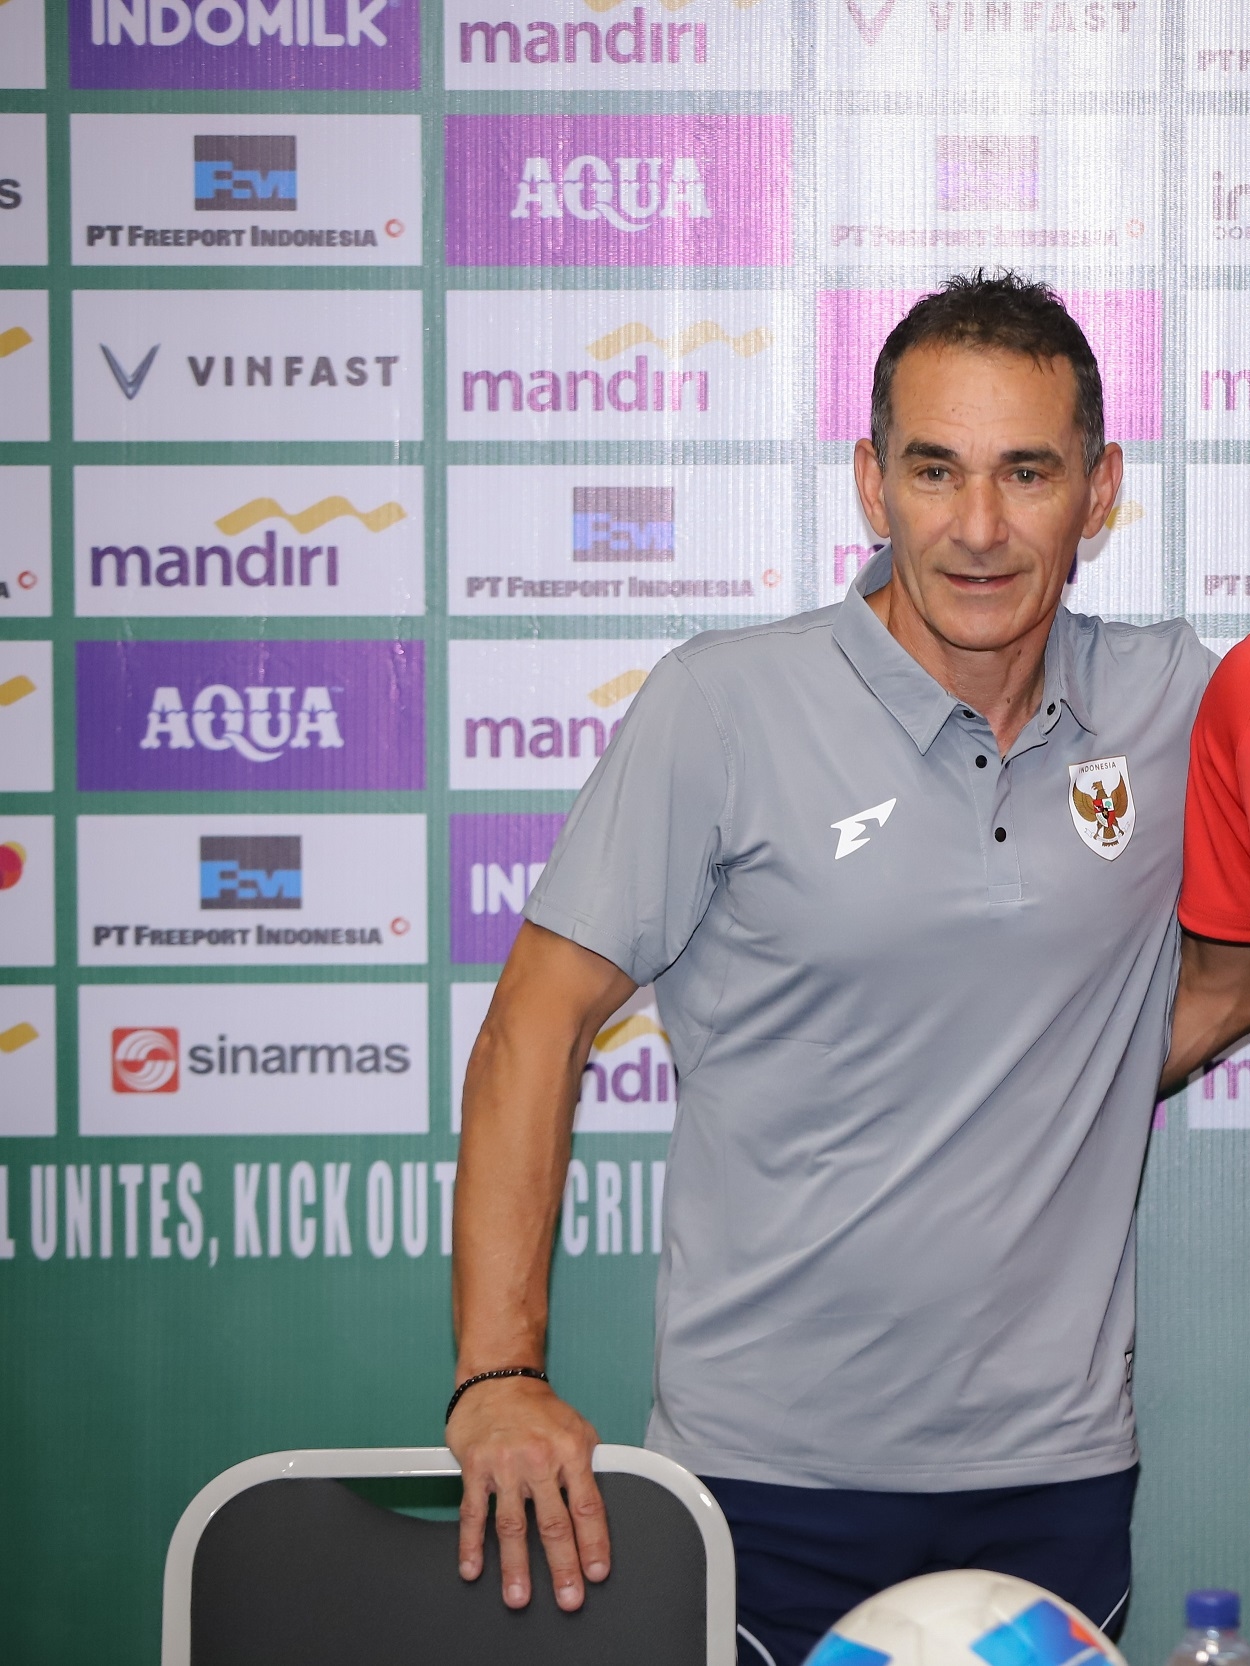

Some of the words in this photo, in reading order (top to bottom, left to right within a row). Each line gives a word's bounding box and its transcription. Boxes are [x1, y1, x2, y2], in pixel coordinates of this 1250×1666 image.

[91, 0, 387, 47] INDOMILK
[460, 6, 707, 64] mandiri
[510, 155, 713, 232] AQUA
[87, 225, 124, 247] PT
[128, 225, 246, 248] FREEPORT
[251, 225, 378, 248] INDONESIA
[187, 356, 400, 387] VINFAST
[463, 355, 708, 412] mandiri
[90, 530, 339, 588] mandiri
[466, 577, 503, 598] PT
[507, 577, 624, 598] FREEPORT
[1204, 575, 1240, 596] PT
[139, 684, 345, 762] AQUA
[1079, 761, 1117, 774] INDONESIA
[93, 926, 130, 946] PT
[134, 926, 251, 947] FREEPORT
[256, 925, 383, 946] INDONESIA
[188, 1034, 411, 1074] sinarmas
[30, 1161, 219, 1268] UNITES,
[234, 1160, 353, 1258] KICK
[365, 1160, 457, 1259] OUT
